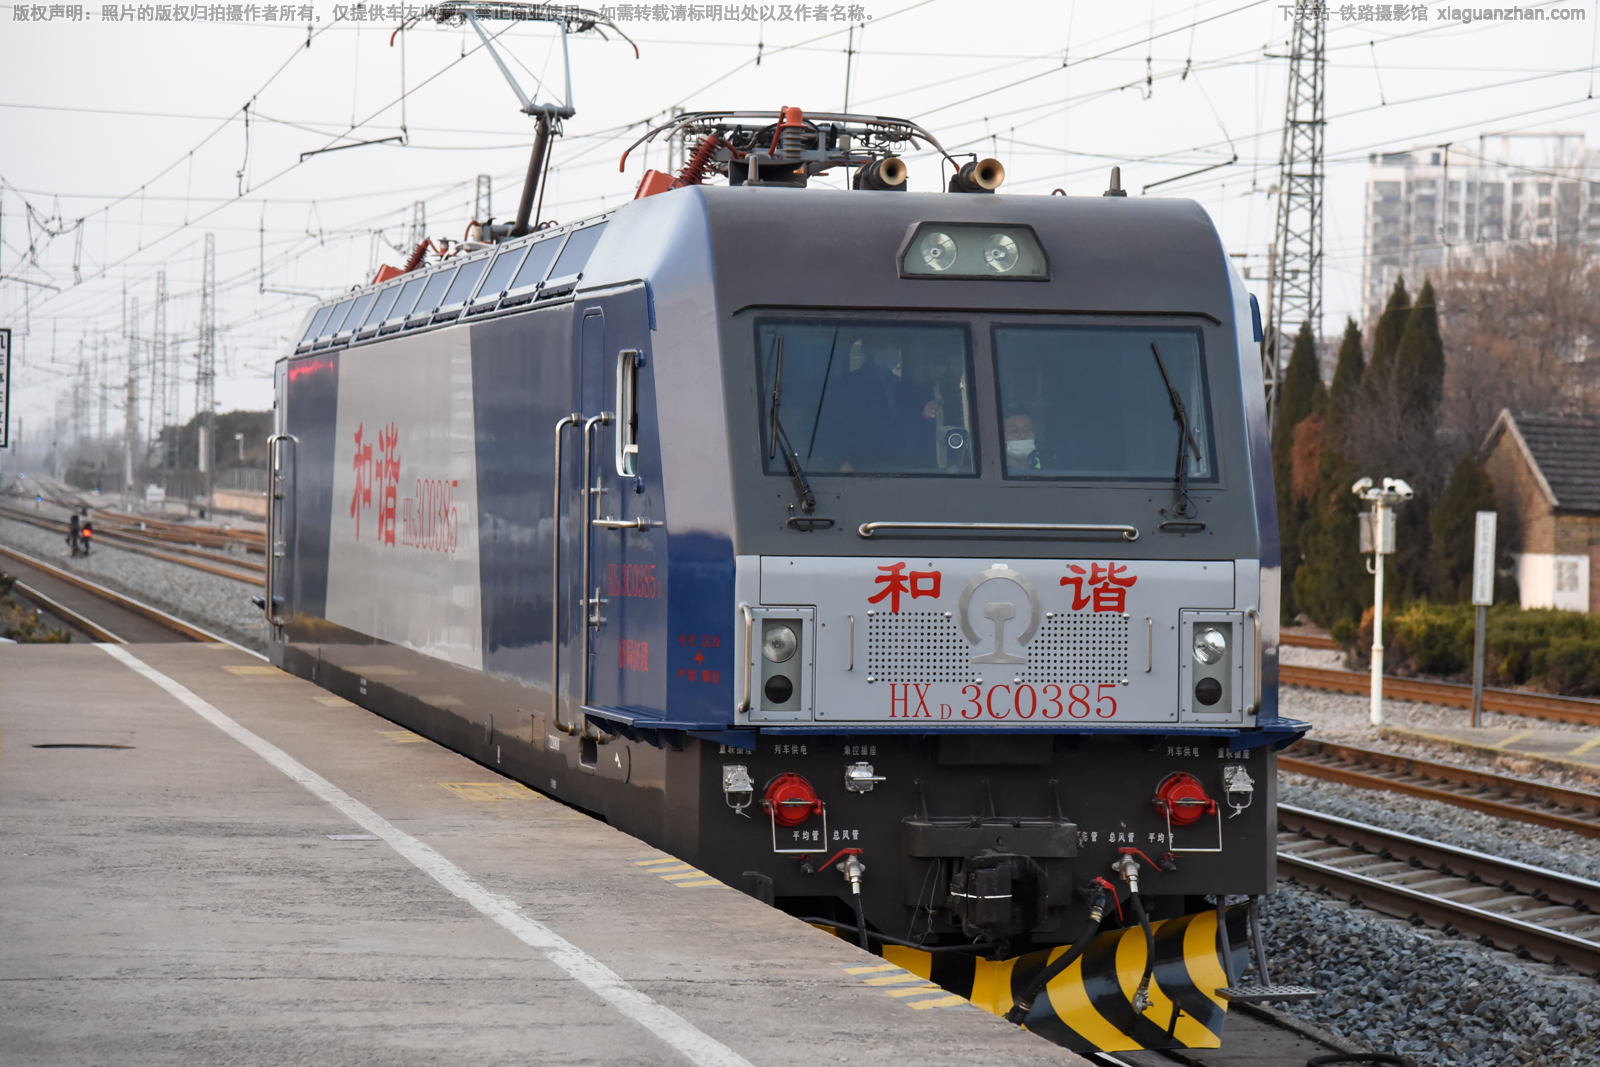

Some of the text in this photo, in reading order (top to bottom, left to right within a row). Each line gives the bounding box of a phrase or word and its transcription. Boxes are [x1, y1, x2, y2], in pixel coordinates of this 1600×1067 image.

[350, 421, 401, 548] 和谐
[868, 561, 1138, 614] 和 谐
[773, 744, 808, 755] 列车供电
[1166, 746, 1200, 757] 列车供电
[792, 830, 819, 841] 平均管
[832, 829, 860, 841] 总风管
[1109, 831, 1135, 843] 总风管
